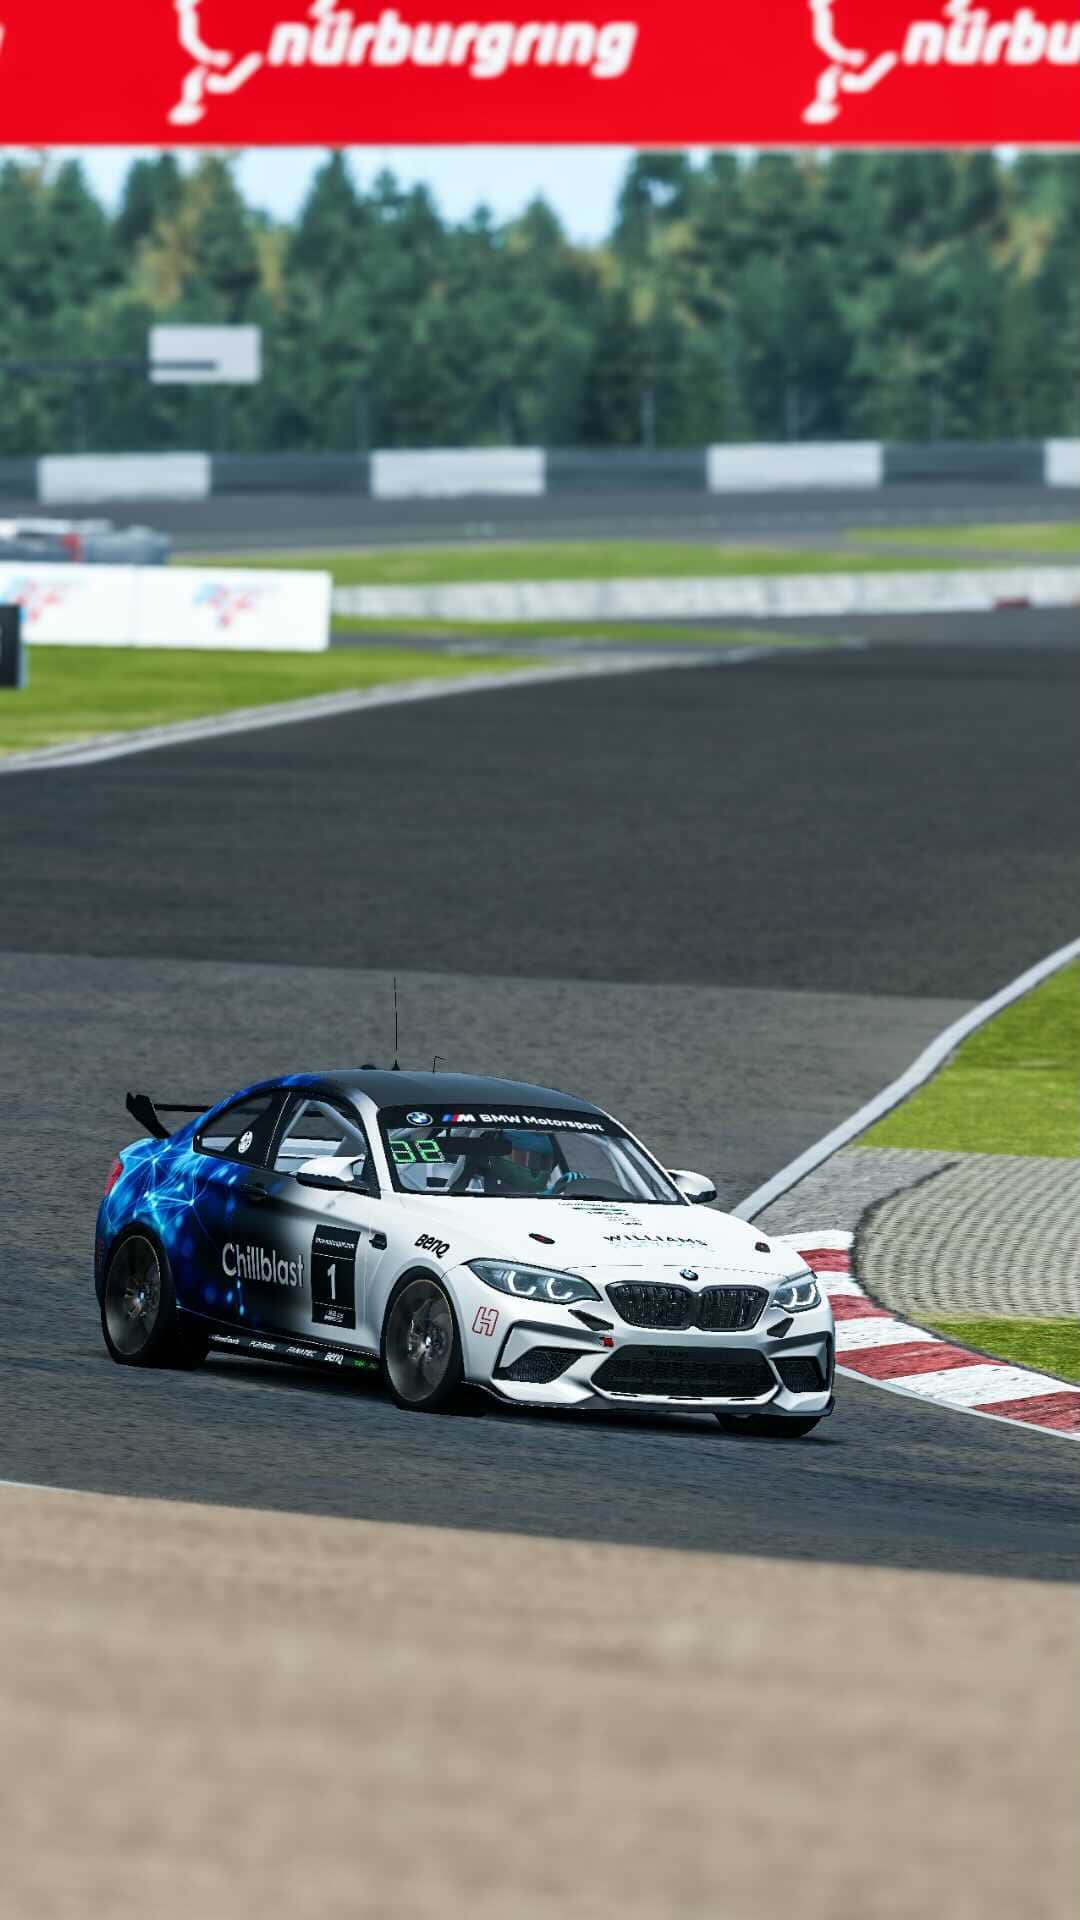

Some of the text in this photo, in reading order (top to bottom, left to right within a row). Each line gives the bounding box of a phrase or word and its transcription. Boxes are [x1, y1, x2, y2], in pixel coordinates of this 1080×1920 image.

[479, 1113, 521, 1124] BMW
[522, 1115, 605, 1132] Motorsport
[414, 1233, 450, 1259] BenQ
[222, 1242, 304, 1288] Chillblast
[327, 1263, 336, 1300] 1
